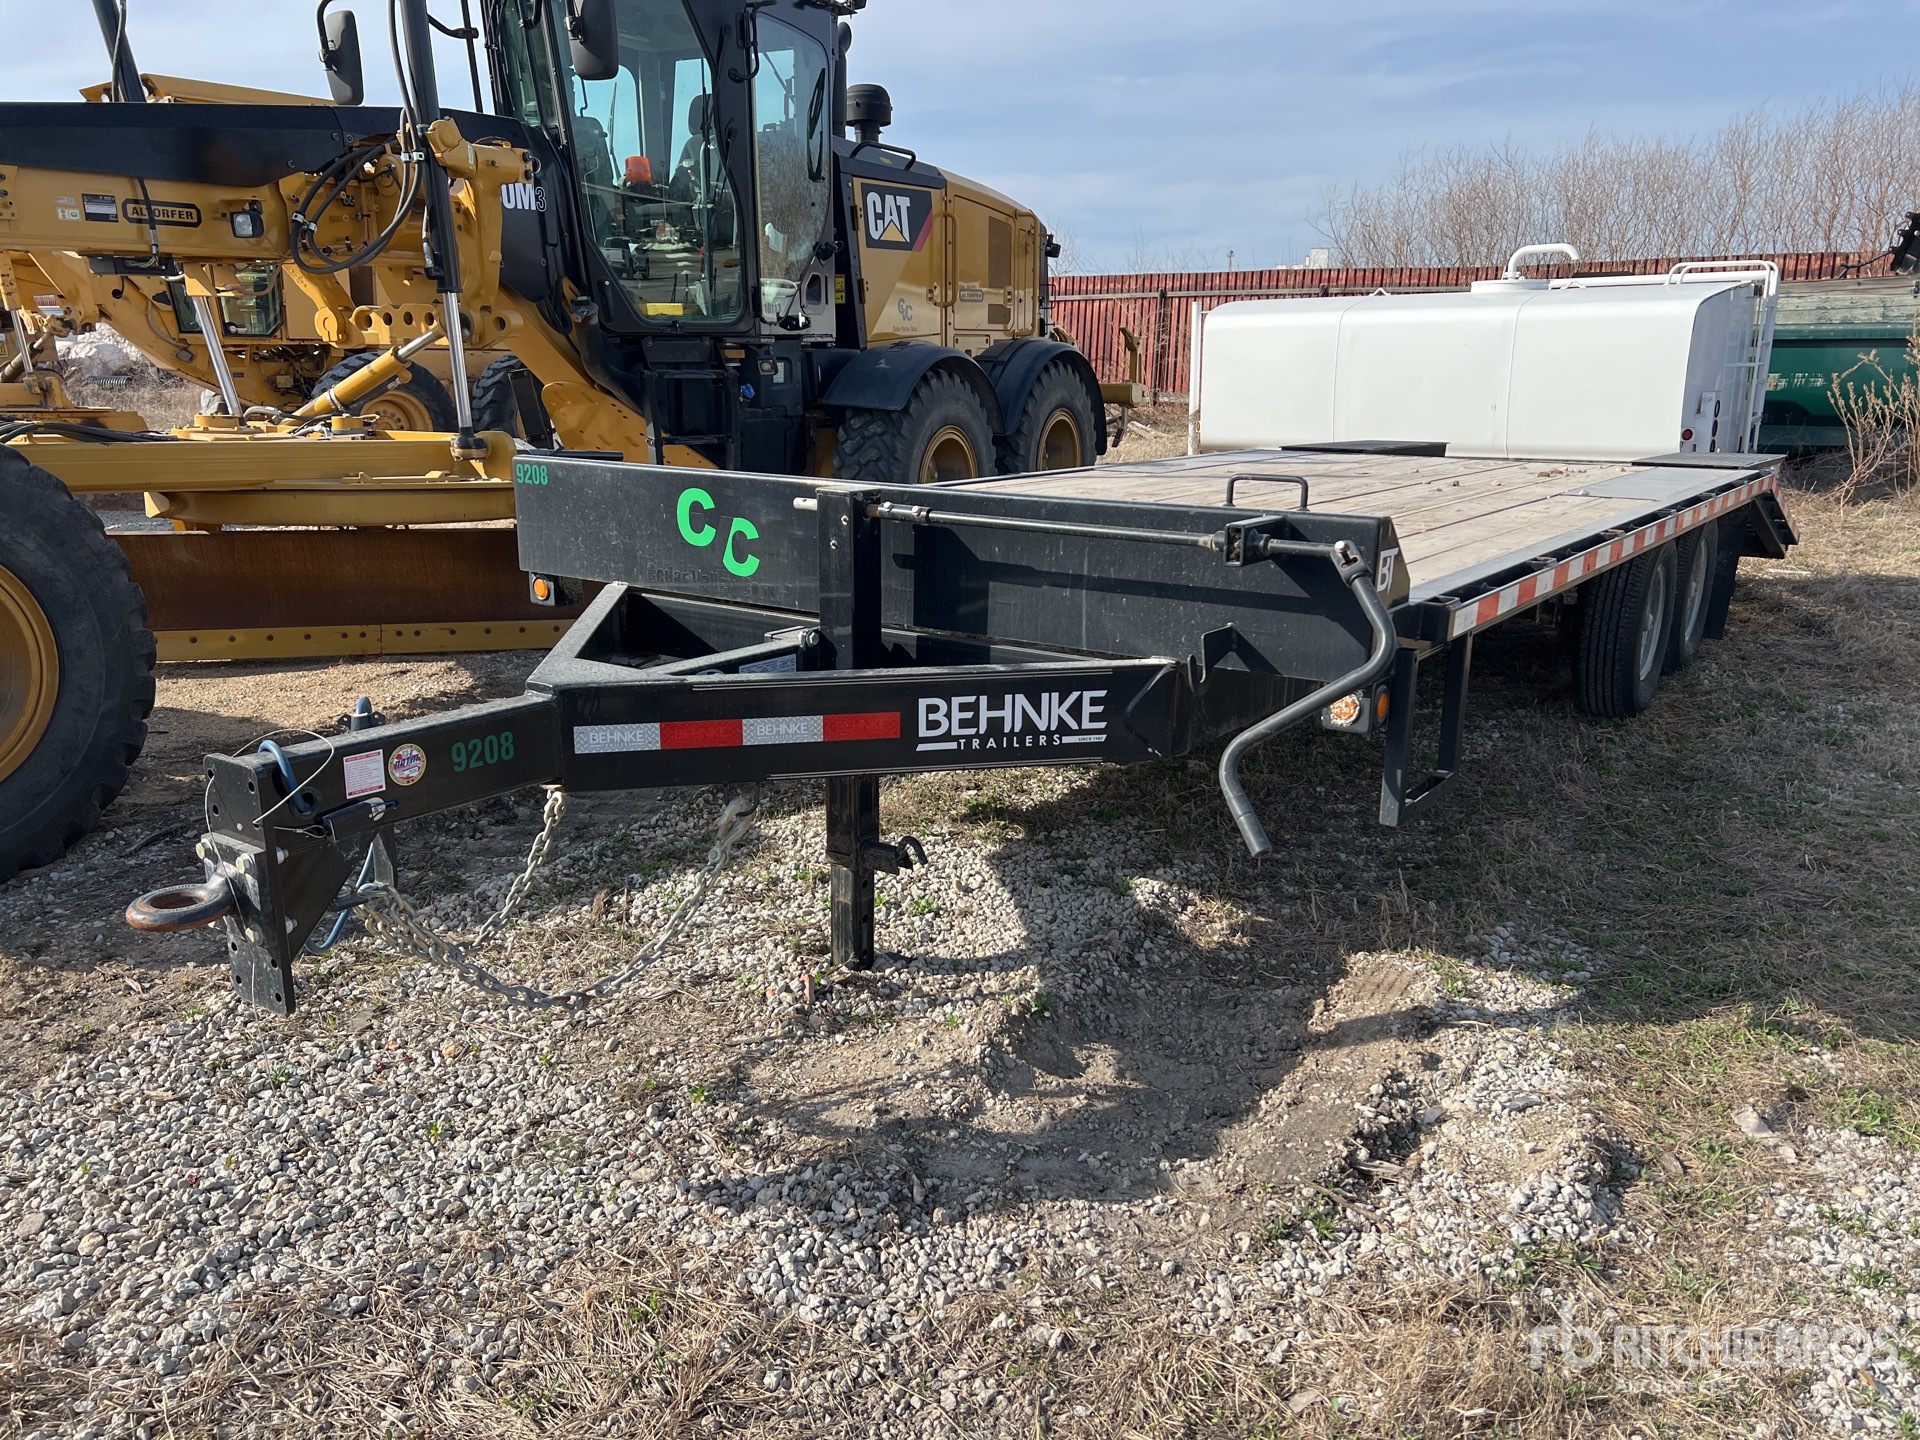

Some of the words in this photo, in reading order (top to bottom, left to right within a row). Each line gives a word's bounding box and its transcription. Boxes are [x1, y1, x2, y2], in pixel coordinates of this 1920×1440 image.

[866, 191, 911, 243] CAT
[516, 463, 549, 486] 9208
[918, 689, 1108, 738] BEHNKE
[589, 730, 645, 744] BEHNKE
[756, 722, 808, 736] BEHNKE
[451, 731, 515, 773] 9208
[959, 734, 1061, 750] TRAILERS
